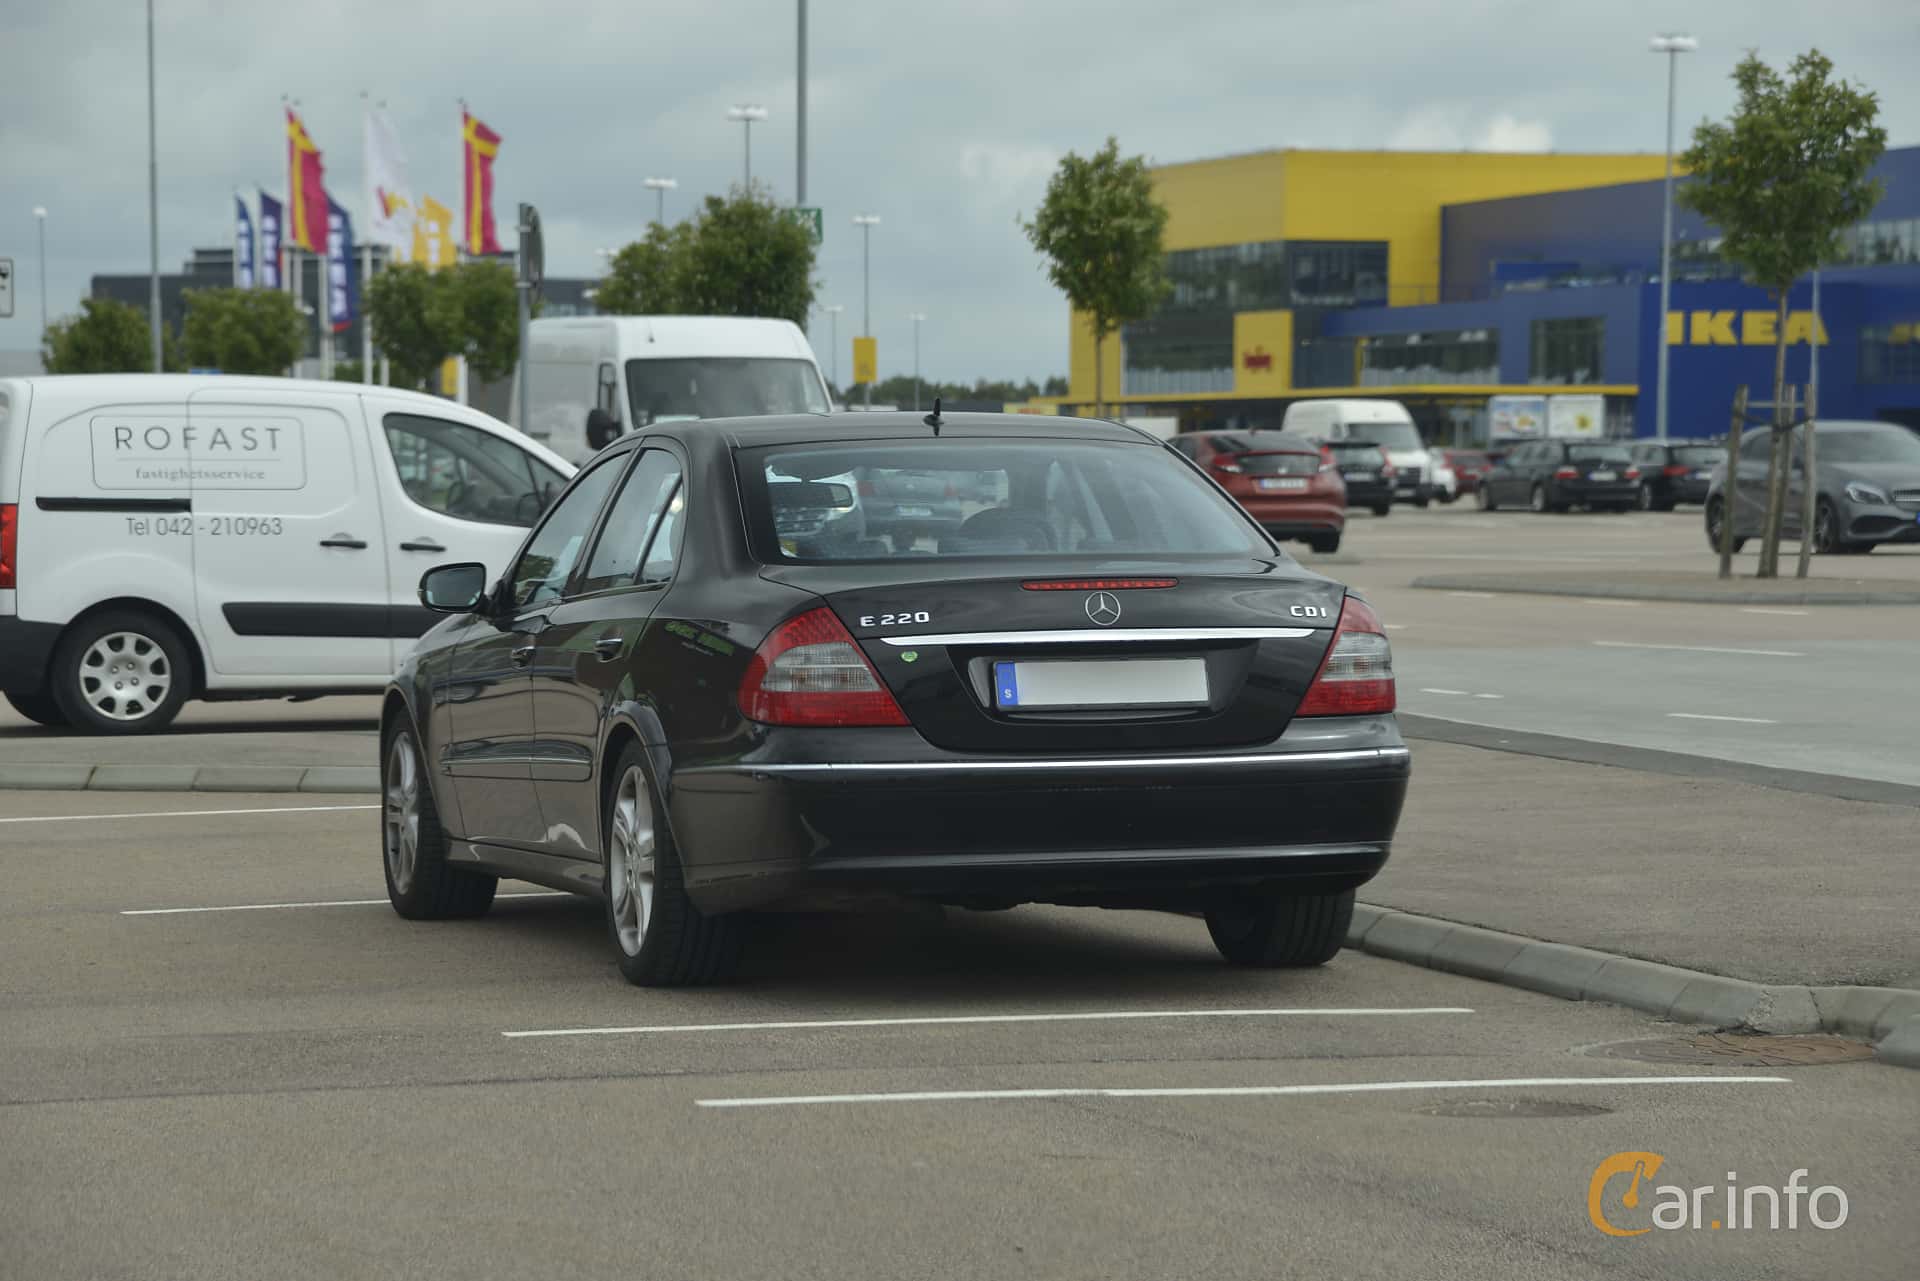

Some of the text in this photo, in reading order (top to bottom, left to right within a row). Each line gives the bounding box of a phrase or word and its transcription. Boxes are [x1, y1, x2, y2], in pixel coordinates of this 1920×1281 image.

[1664, 310, 1829, 346] IKEA
[114, 426, 281, 451] ROFAST
[135, 467, 265, 482] fastighetsservice
[126, 517, 151, 535] Tel
[155, 517, 193, 536] 042
[210, 516, 283, 536] 210963
[860, 611, 930, 627] E 220
[1290, 605, 1327, 618] CDI
[1003, 688, 1013, 699] S
